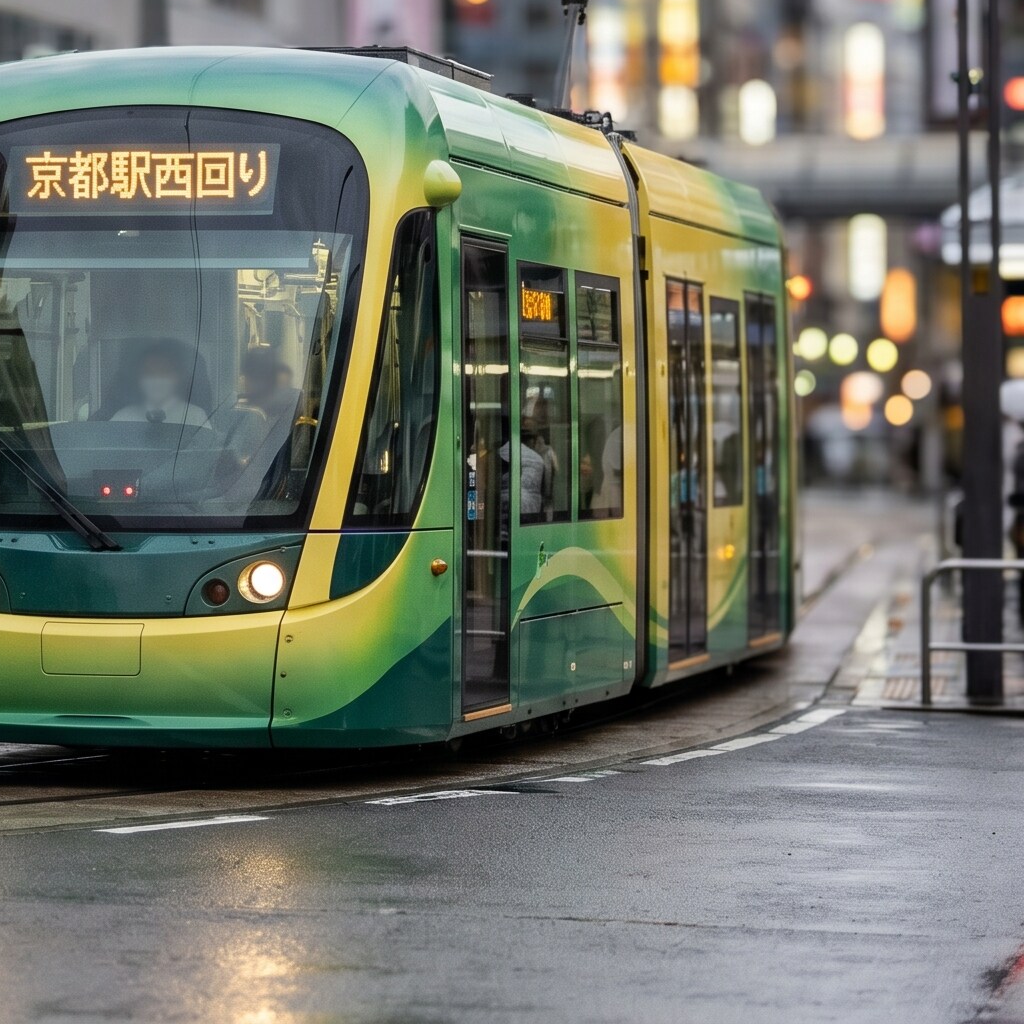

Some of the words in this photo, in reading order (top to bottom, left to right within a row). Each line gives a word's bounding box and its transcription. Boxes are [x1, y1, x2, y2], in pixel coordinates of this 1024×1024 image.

[25, 150, 268, 200] 京都駅西回り
